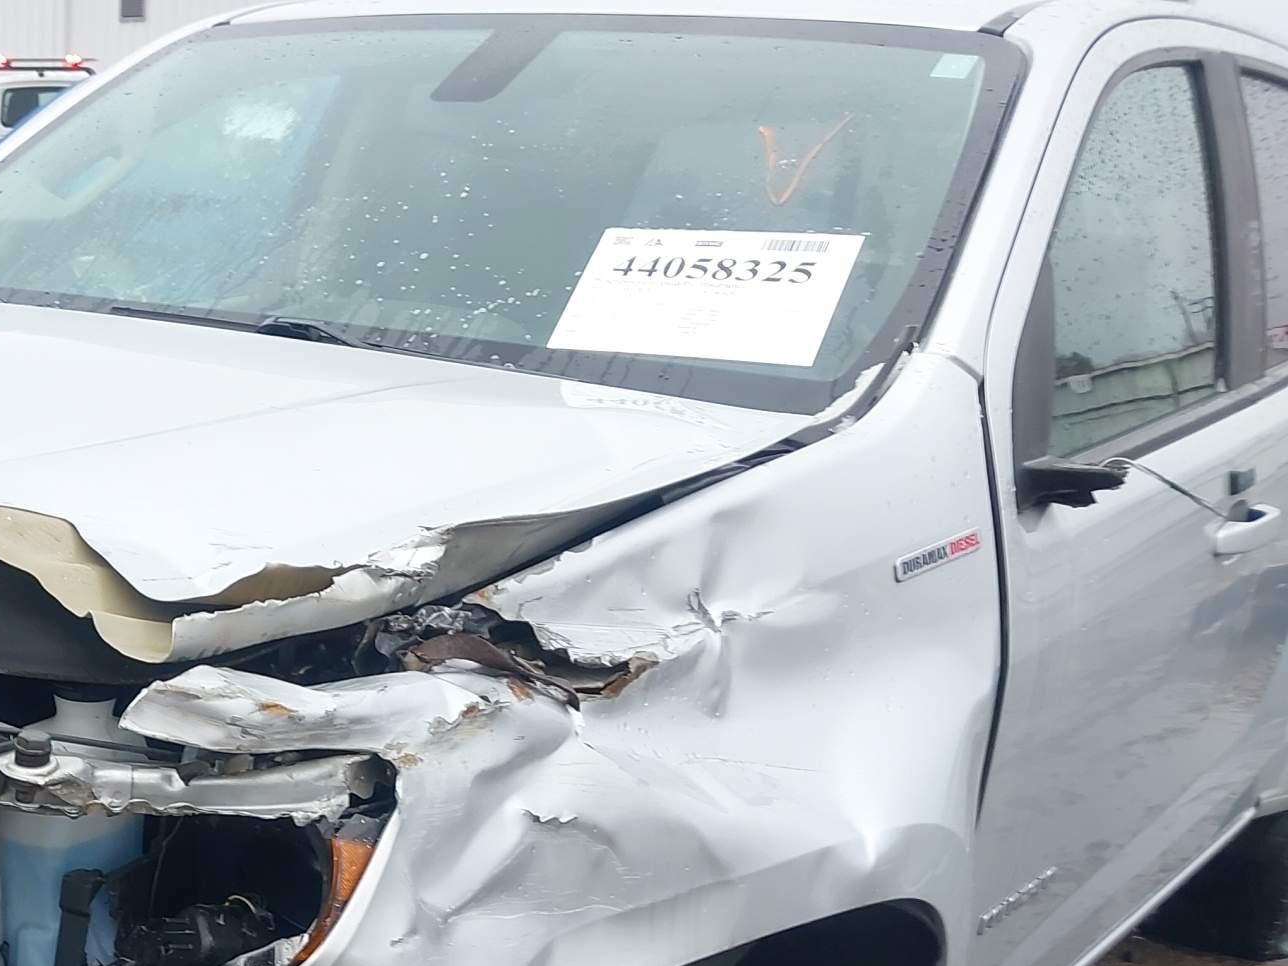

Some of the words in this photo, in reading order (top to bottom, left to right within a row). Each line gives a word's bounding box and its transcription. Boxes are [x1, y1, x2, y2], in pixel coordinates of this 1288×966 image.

[612, 255, 816, 284] 44058325
[903, 545, 948, 575] DURAMAX
[950, 533, 979, 555] DIESEL
